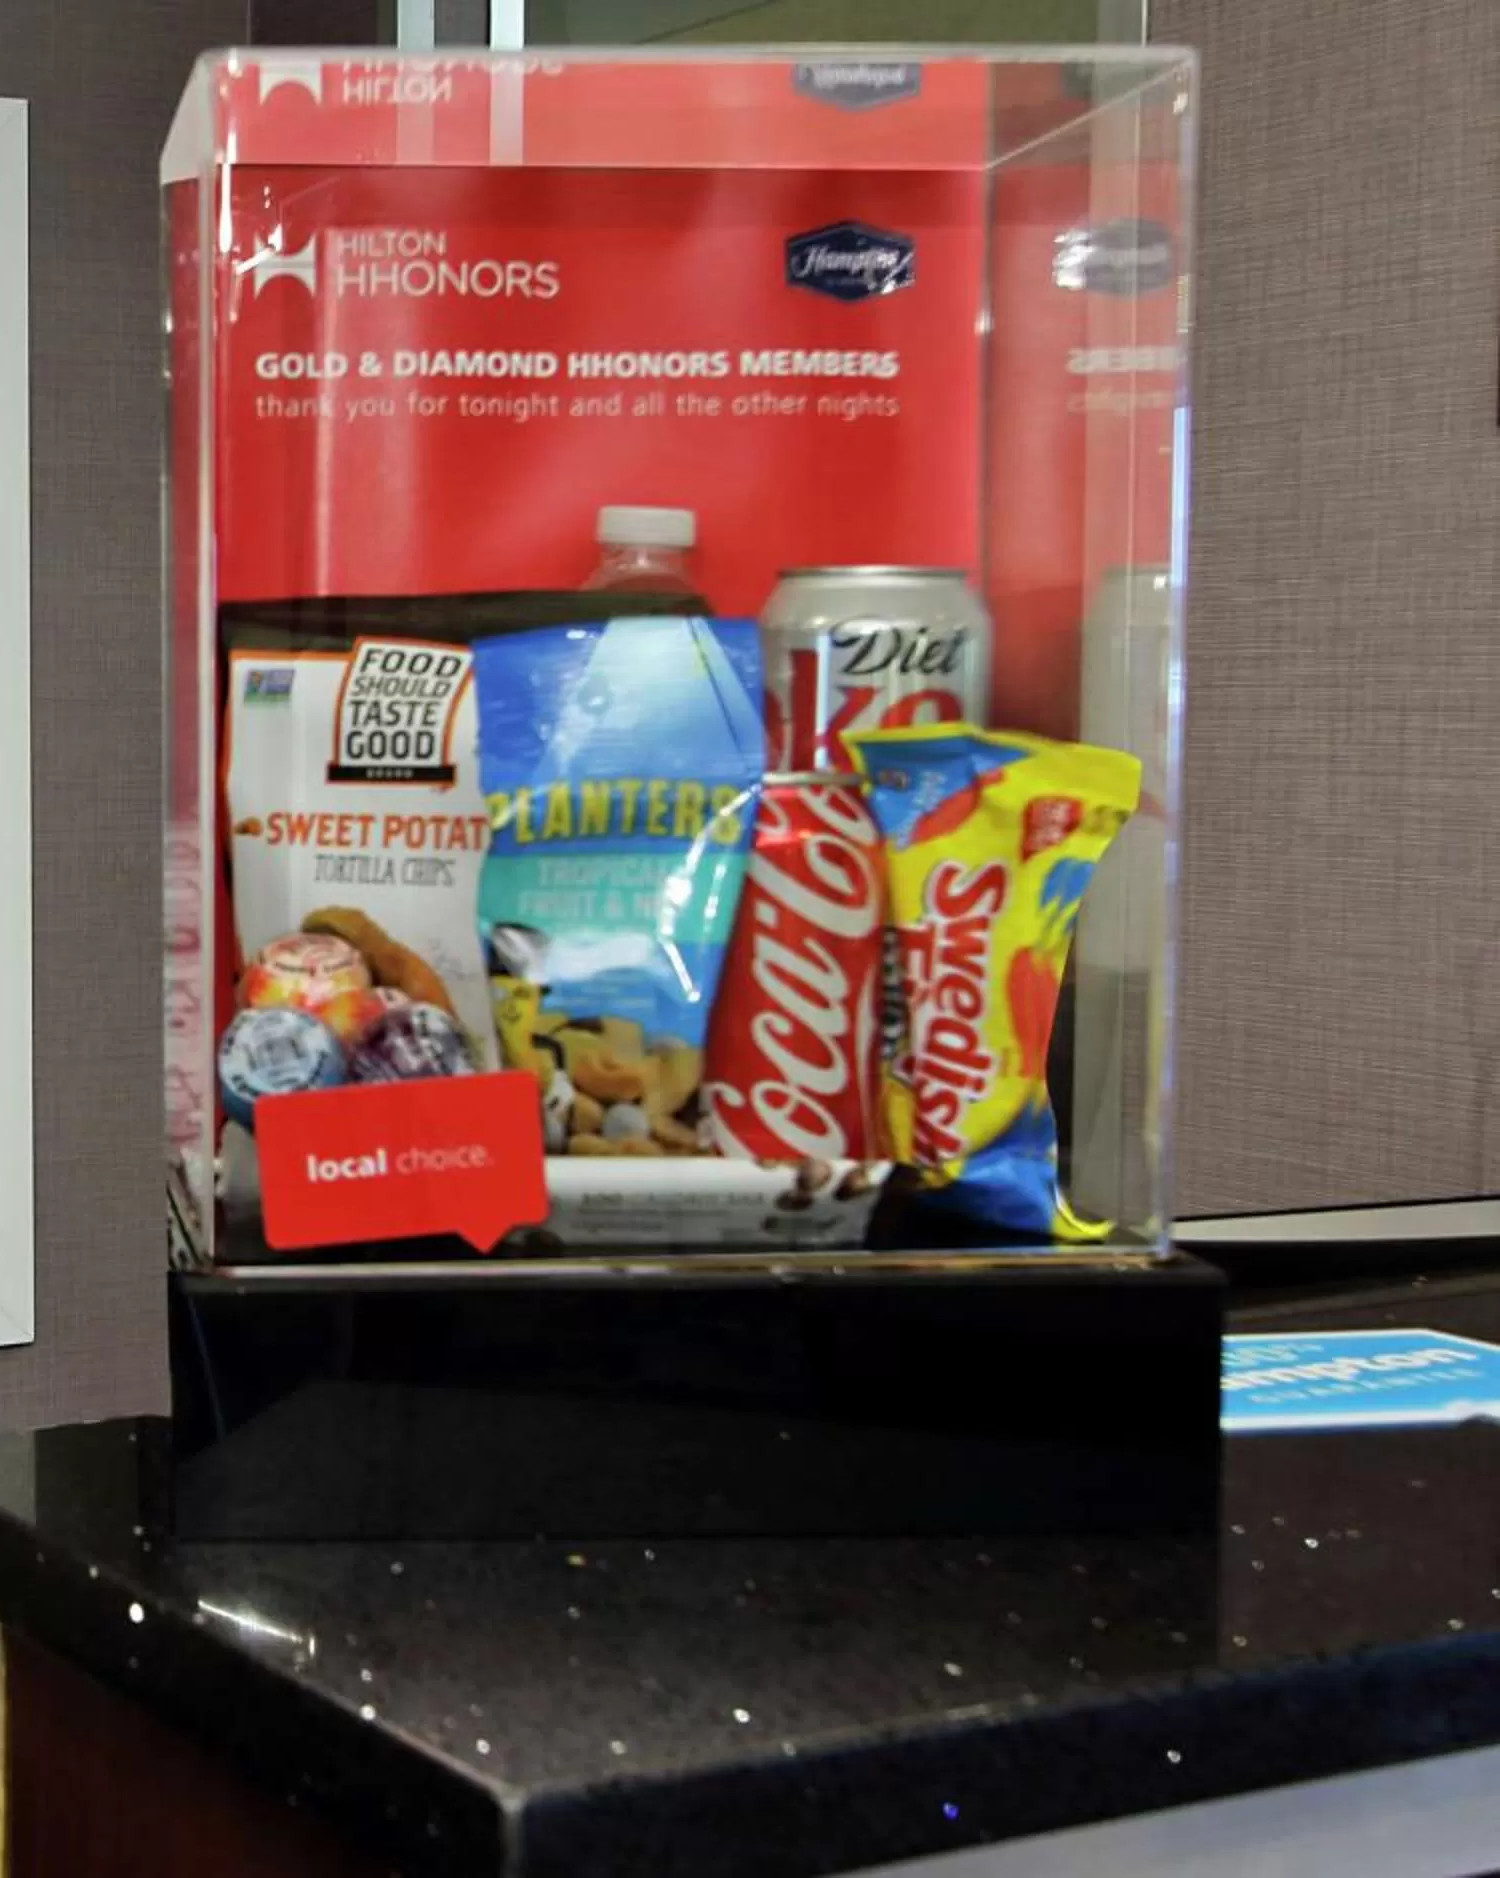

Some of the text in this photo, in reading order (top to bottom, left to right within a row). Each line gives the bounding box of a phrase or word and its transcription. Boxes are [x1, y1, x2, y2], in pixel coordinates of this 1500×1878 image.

[338, 231, 448, 257] HILTON
[336, 260, 561, 299] HHONORS
[255, 349, 901, 380] GOLD & DIAMOND HHONORS MEMBERS
[256, 390, 901, 423] thank you for tonight and all the other nights
[359, 648, 462, 677] FOOD
[830, 618, 968, 676] Diet
[350, 675, 452, 699] SHOULD
[348, 699, 441, 727] TASTE
[346, 730, 436, 761] GOOD
[266, 811, 490, 852] SWEET POTAT
[306, 1147, 388, 1183] local
